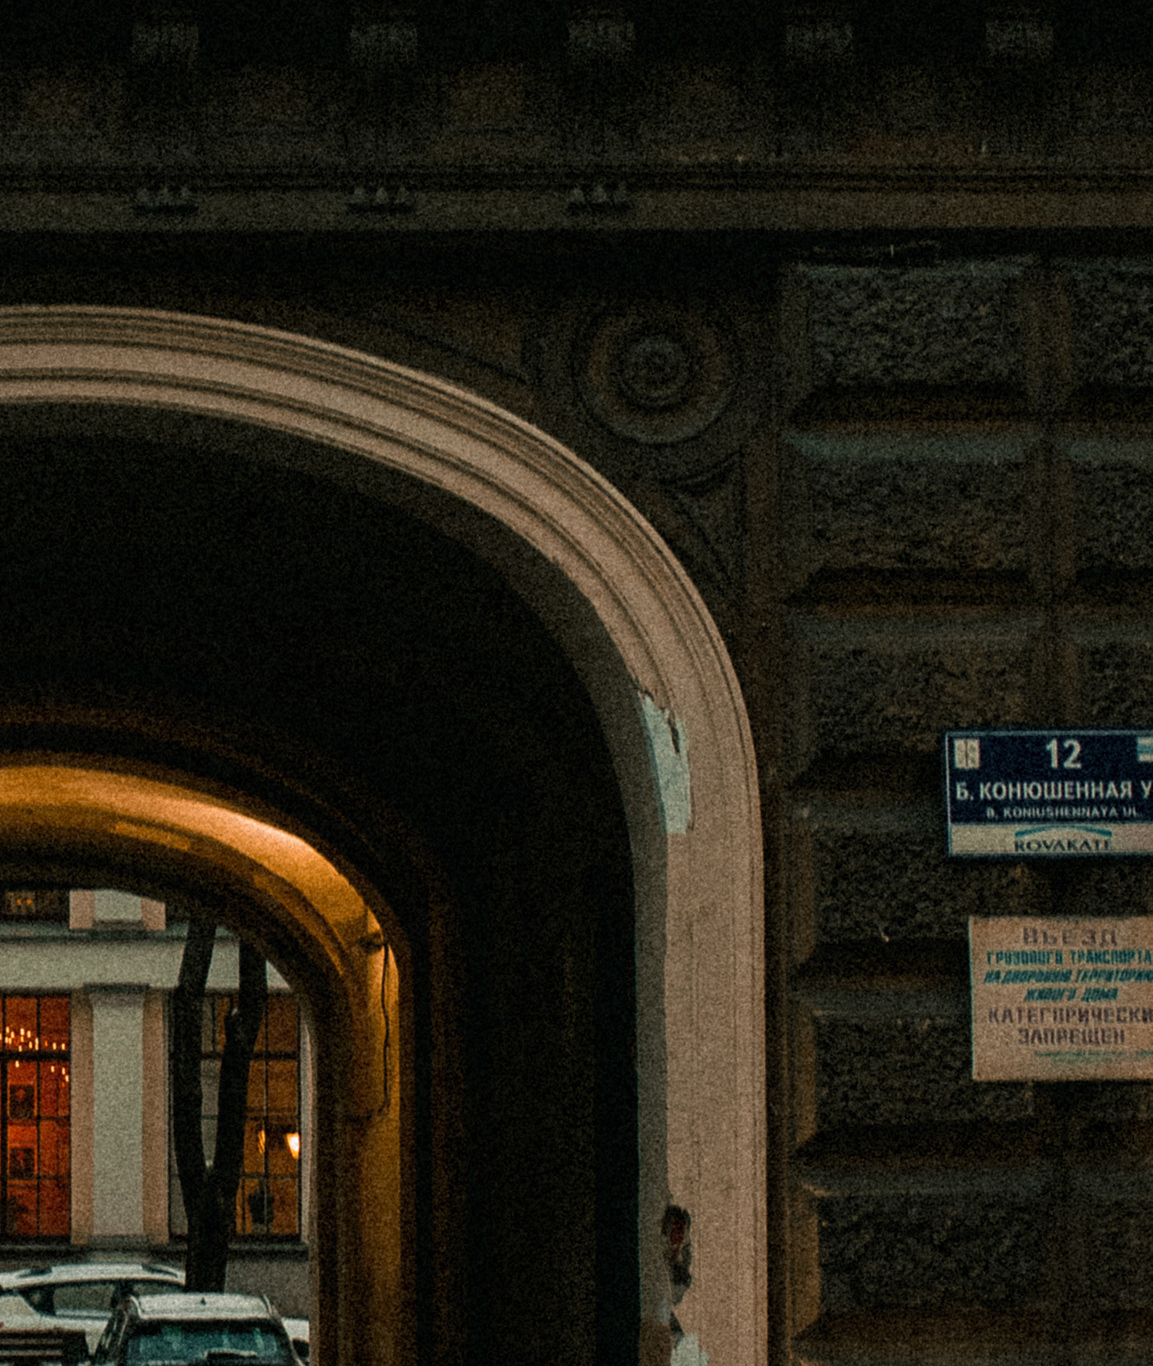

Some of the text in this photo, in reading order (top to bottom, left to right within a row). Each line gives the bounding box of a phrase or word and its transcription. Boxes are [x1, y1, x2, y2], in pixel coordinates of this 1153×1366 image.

[1046, 738, 1082, 770] 12
[956, 781, 974, 801] Б.
[980, 780, 1133, 801] КОНЮШЕННАЯ
[1003, 806, 1119, 819] KONIUSHENNAYA
[986, 949, 1153, 965] ГРУЗОВОГО ТРАНСПОРТА
[983, 969, 1001, 983] НА
[1081, 987, 1119, 1003] ДОМА
[1018, 1027, 1126, 1046] ЗАПРЕЩЕН
